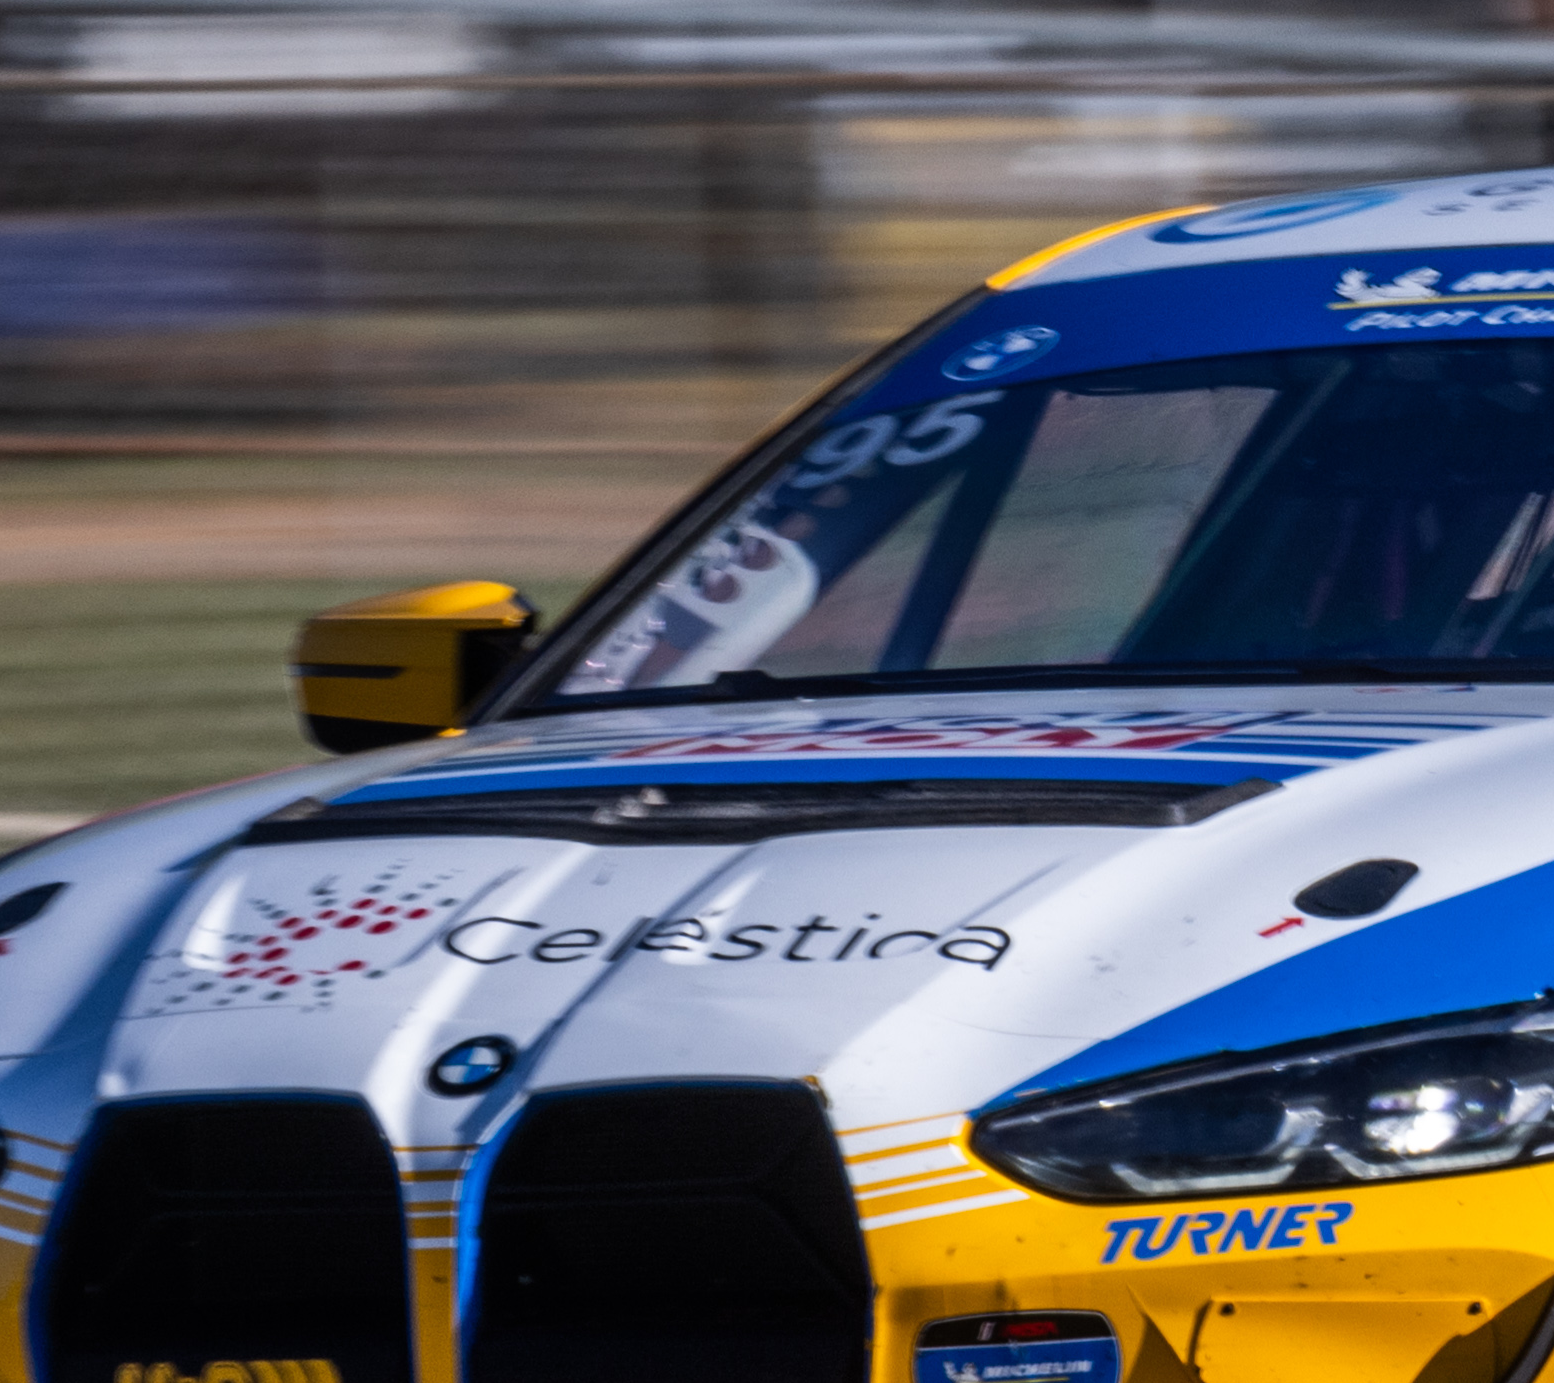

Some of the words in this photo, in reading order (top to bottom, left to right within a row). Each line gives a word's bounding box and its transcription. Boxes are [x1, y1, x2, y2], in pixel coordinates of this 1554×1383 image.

[788, 389, 1008, 490] 95
[445, 913, 1013, 971] Celestica
[1100, 1201, 1354, 1265] TURNER
